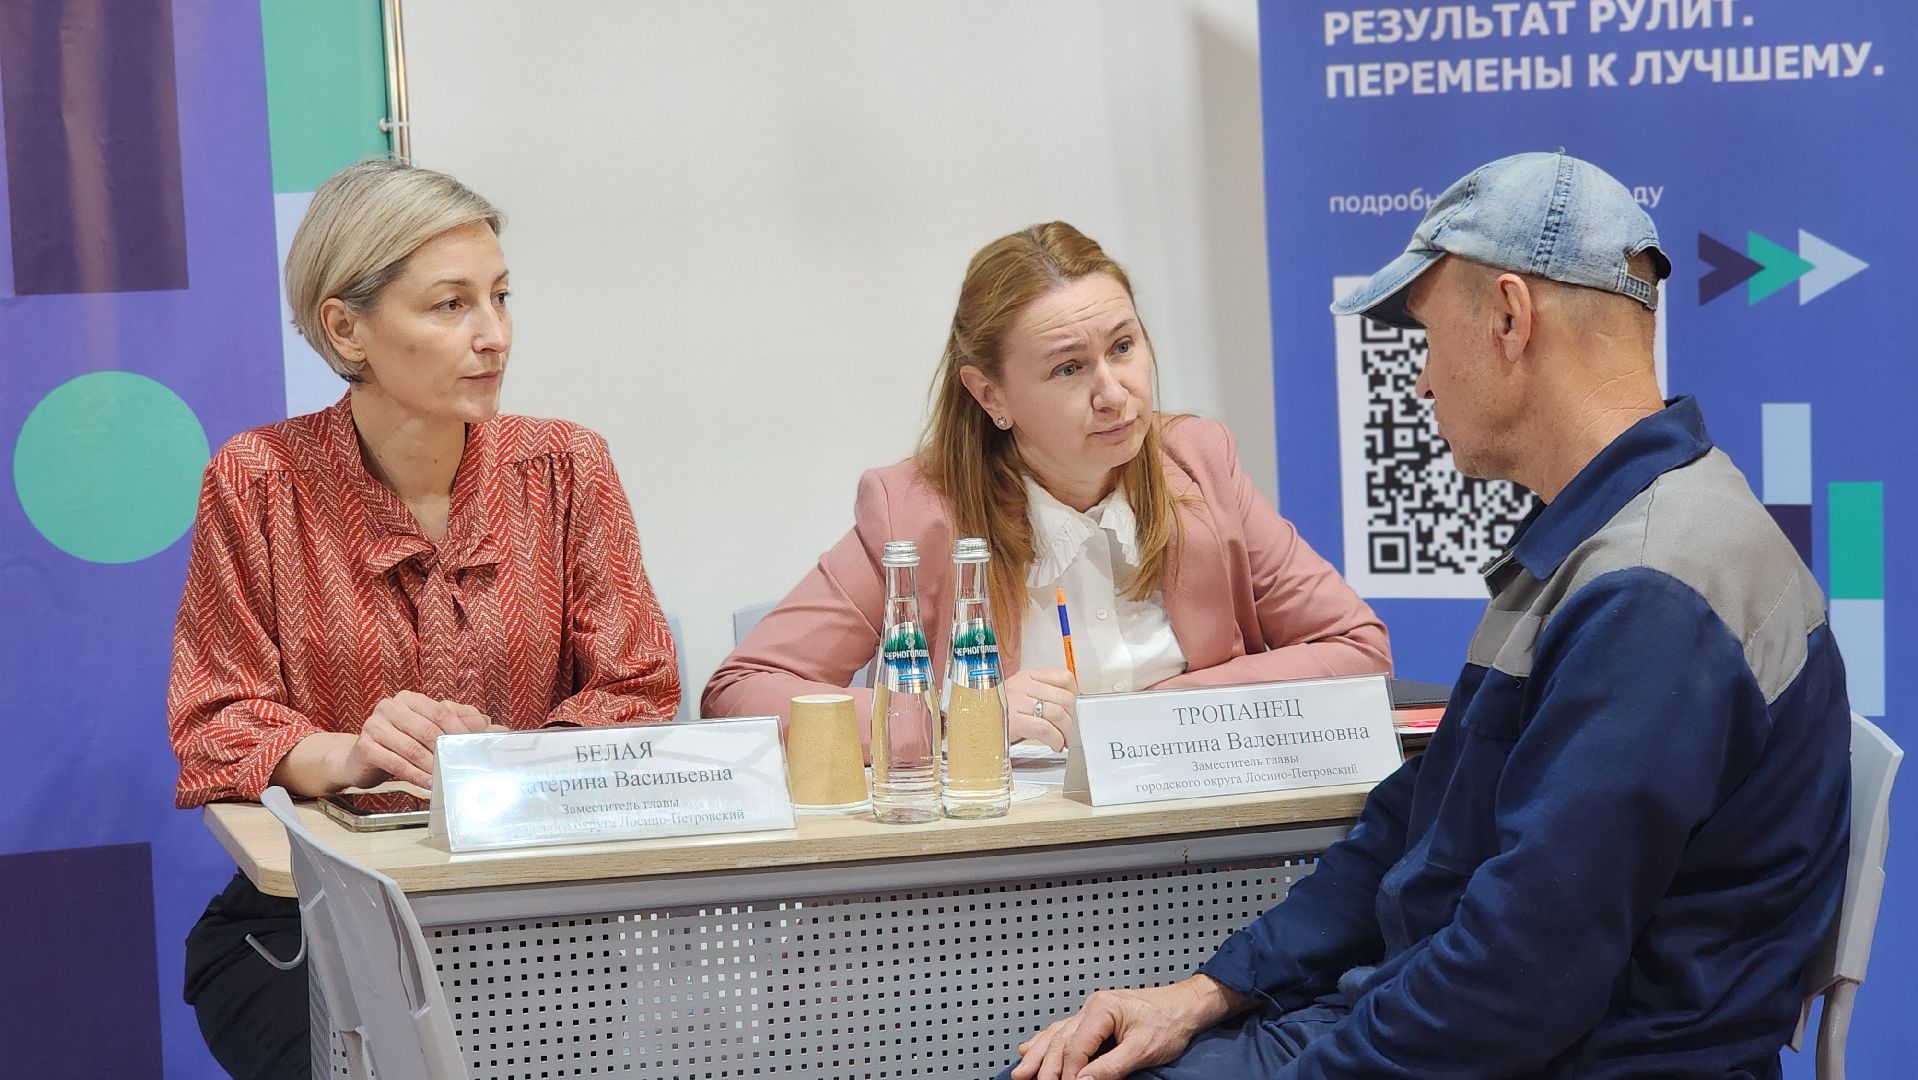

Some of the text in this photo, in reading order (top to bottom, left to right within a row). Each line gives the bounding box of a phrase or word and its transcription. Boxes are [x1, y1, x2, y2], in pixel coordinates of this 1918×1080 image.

[1324, 0, 1754, 46] РЕЗУЛЬТАТ РУЛИТ.
[1327, 42, 1884, 98] ПЕРЕМЕНЫ К ЛУЧШЕМУ.
[1329, 187, 1442, 217] подробн
[1173, 698, 1304, 726] ТРОПАНЕЦ
[575, 741, 653, 763] БЕЛАЯ
[1109, 725, 1370, 760] Валентина Валентиновна
[1192, 754, 1299, 771] Заместитель главы
[520, 768, 733, 797] атерина Васильевна
[1136, 763, 1359, 794] городского округа Лосино-Петровский
[561, 799, 679, 815] Заместитель главы
[620, 809, 745, 829] Лосино-Петровский
